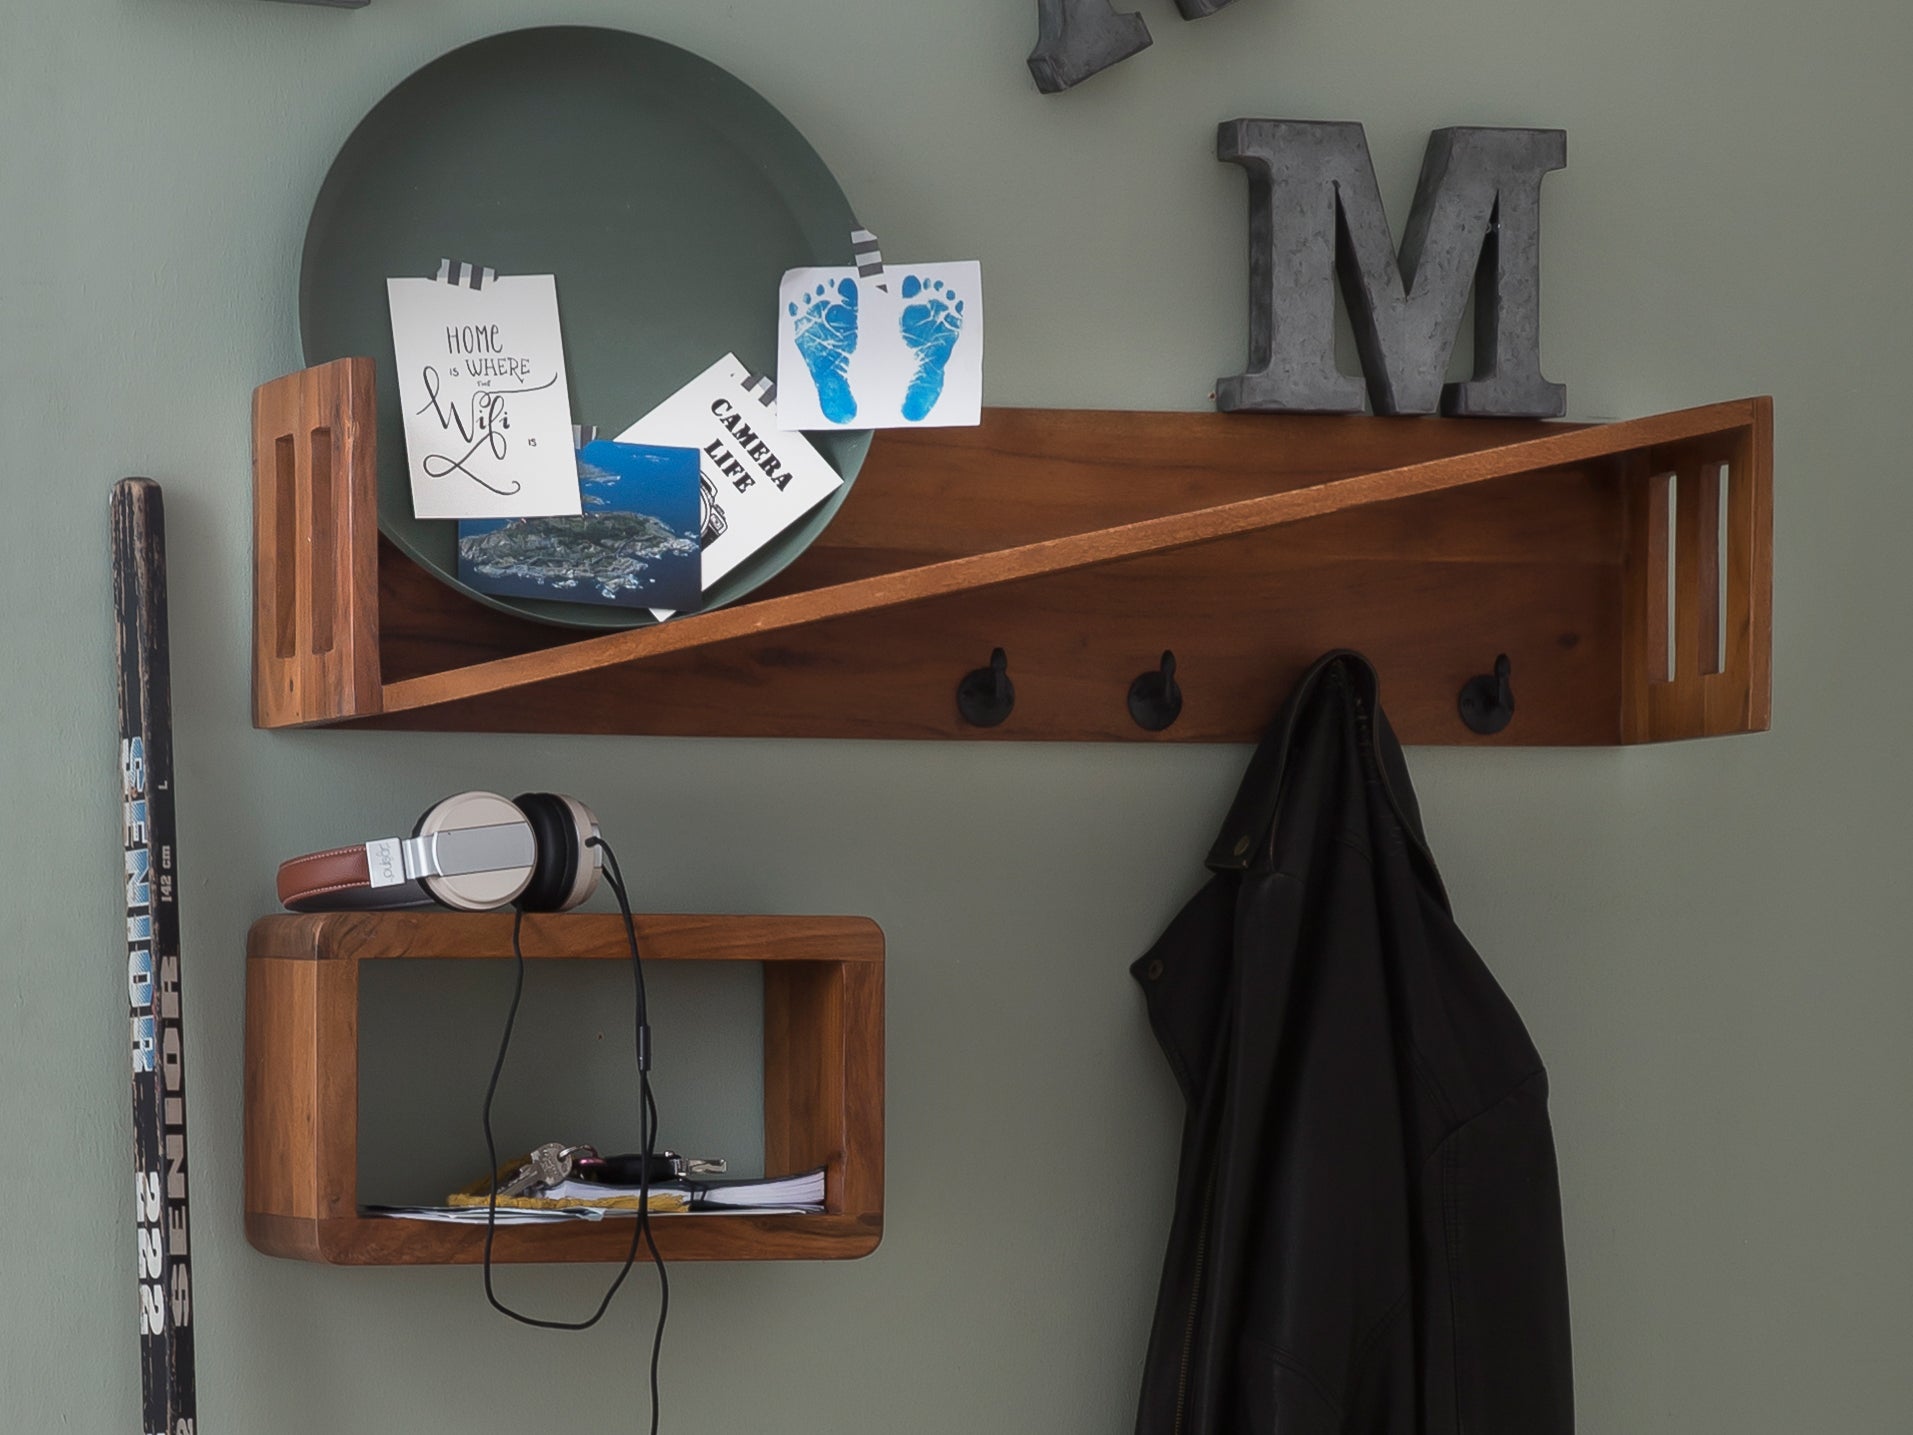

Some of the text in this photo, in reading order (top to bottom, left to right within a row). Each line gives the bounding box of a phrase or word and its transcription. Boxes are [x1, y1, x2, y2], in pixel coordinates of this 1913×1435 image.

[1217, 118, 1567, 417] M
[465, 357, 531, 383] WHERE
[703, 438, 756, 494] LIFE
[711, 398, 794, 492] CAMERA
[122, 736, 165, 1336] SENIOR 222
[158, 779, 189, 1327] SENIOR 142 cm L
